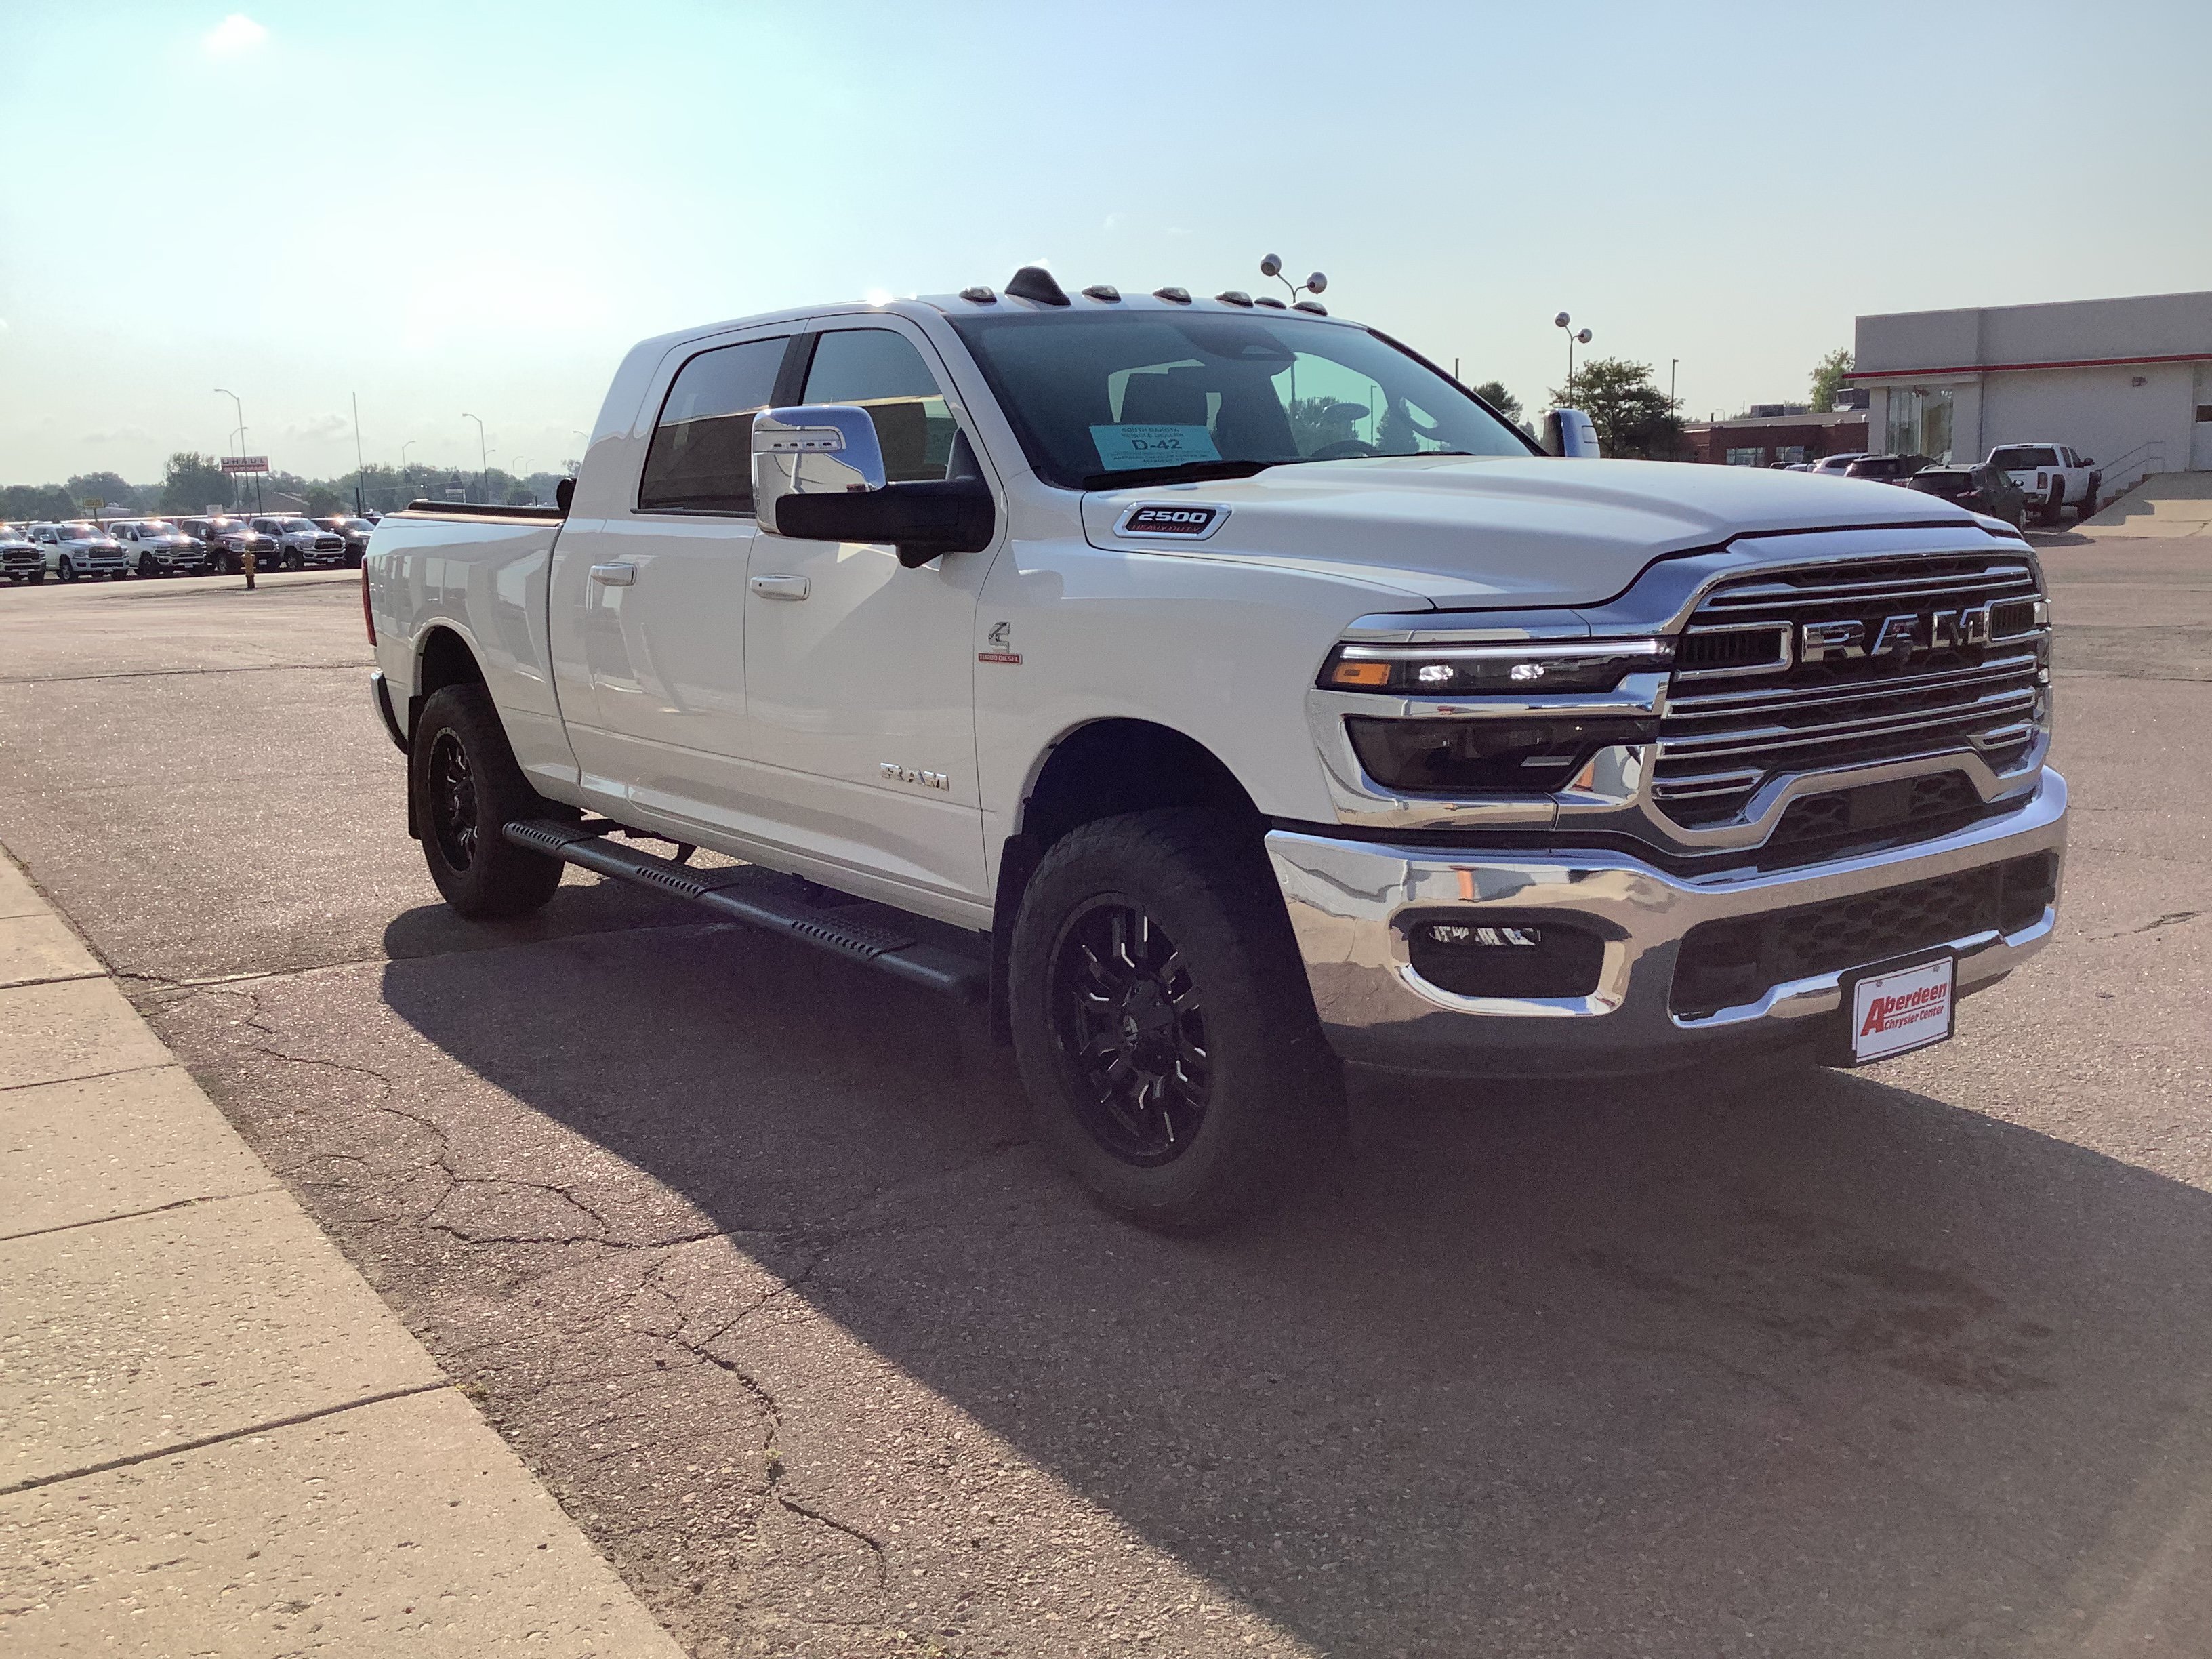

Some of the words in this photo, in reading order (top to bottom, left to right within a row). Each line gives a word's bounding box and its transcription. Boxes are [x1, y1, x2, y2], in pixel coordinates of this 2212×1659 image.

[1132, 439, 1183, 450] D-42
[1139, 510, 1208, 523] 2500
[1801, 609, 1986, 663] RAM
[880, 762, 950, 792] RAM
[1860, 982, 1948, 1037] Aberdeen
[1884, 1015, 1919, 1029] Chrysler
[1919, 1005, 1944, 1020] Center
